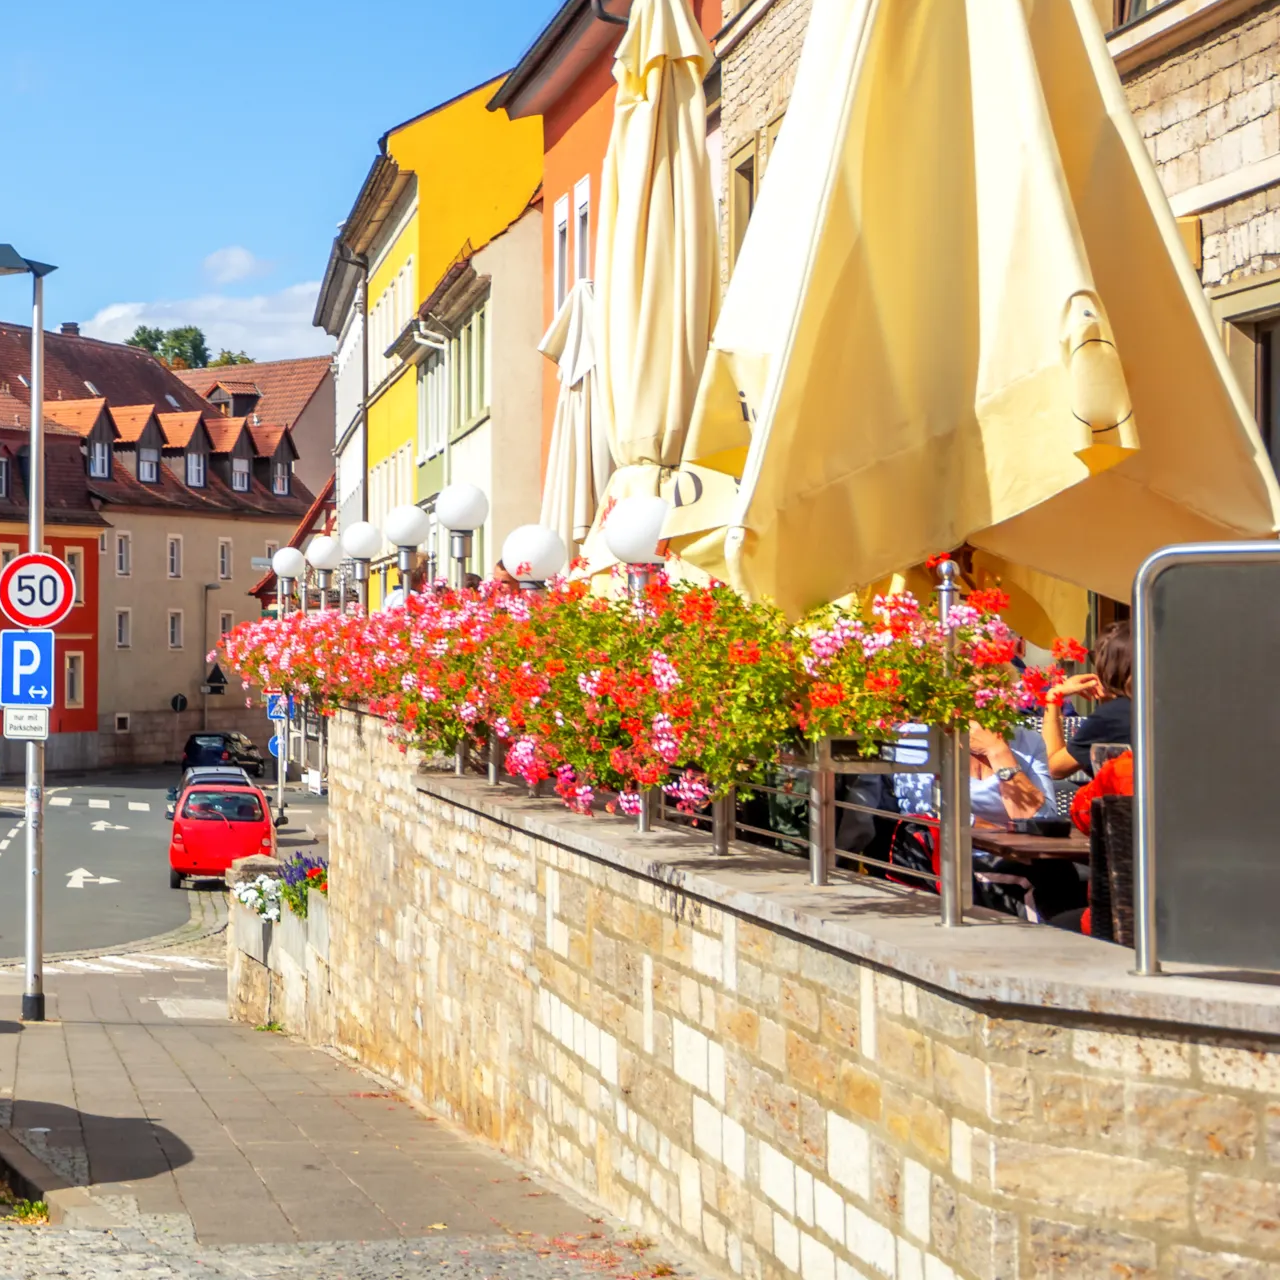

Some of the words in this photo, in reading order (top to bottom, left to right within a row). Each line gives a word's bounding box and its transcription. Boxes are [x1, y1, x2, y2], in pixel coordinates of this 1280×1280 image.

[17, 574, 57, 607] 50
[12, 640, 41, 696] P
[9, 723, 43, 732] Parkschein
[27, 713, 38, 721] mit
